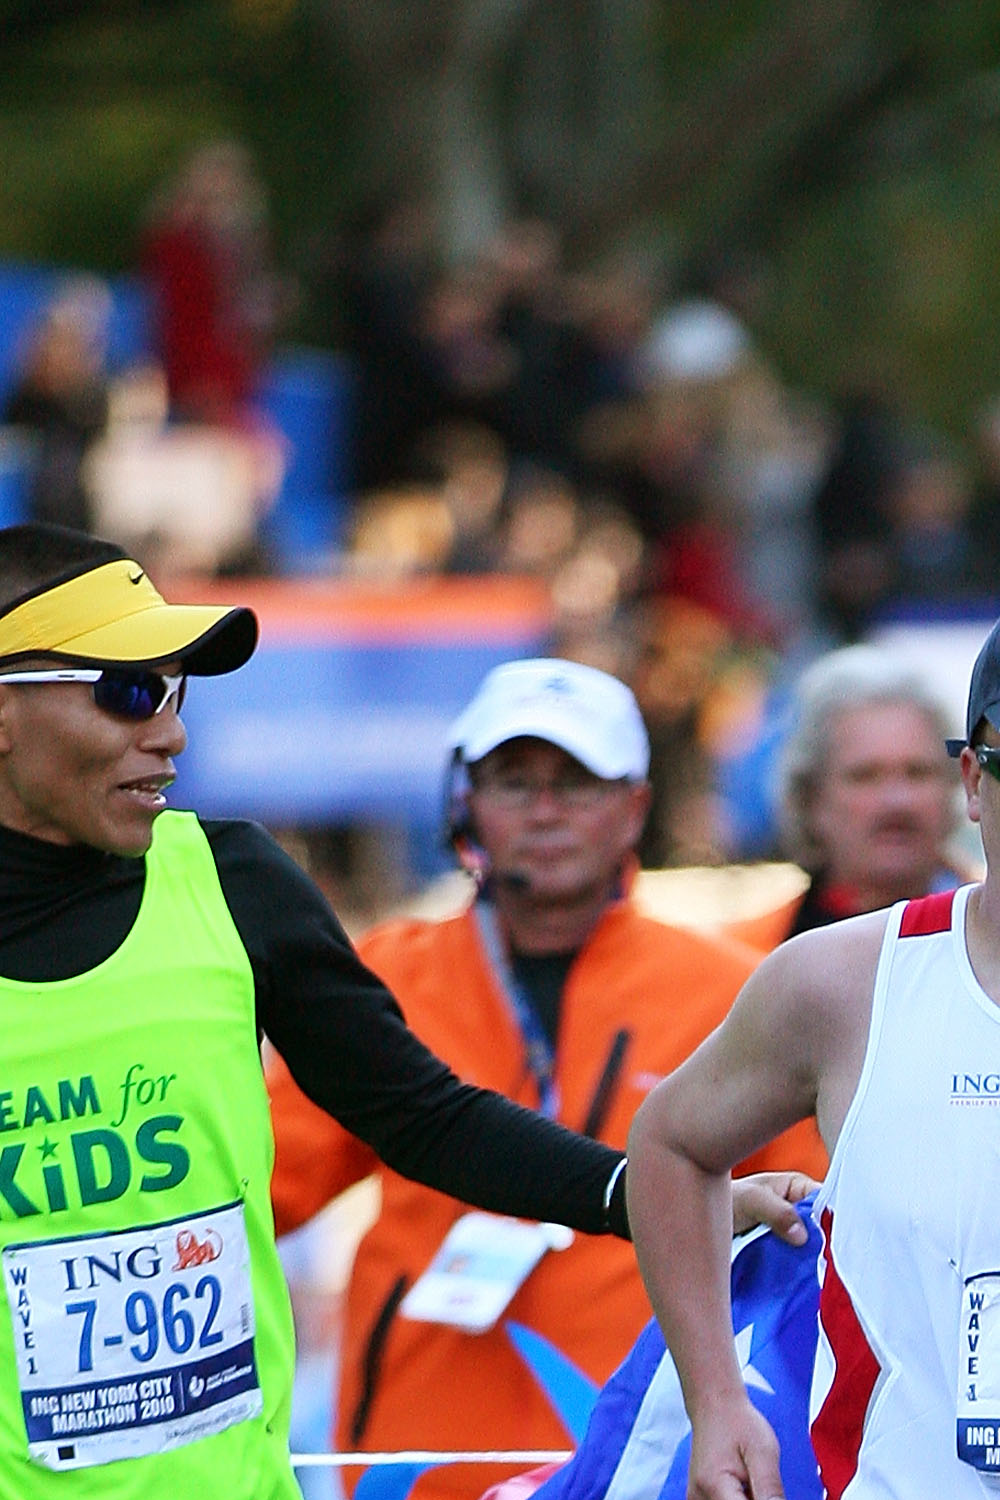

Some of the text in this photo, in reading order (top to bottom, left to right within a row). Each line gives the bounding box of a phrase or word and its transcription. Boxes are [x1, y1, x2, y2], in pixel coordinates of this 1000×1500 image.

[0, 1064, 177, 1132] EAM for
[950, 1073, 1000, 1094] ING
[60, 1243, 164, 1293] ING
[10, 1266, 35, 1350] WAVE
[65, 1274, 224, 1373] 7-962
[967, 1292, 985, 1375] WAVE
[31, 1376, 172, 1417] ING NEW YORK CITY
[52, 1403, 137, 1434] MARATHON
[140, 1397, 175, 1420] 2010
[967, 1427, 994, 1446] ING
